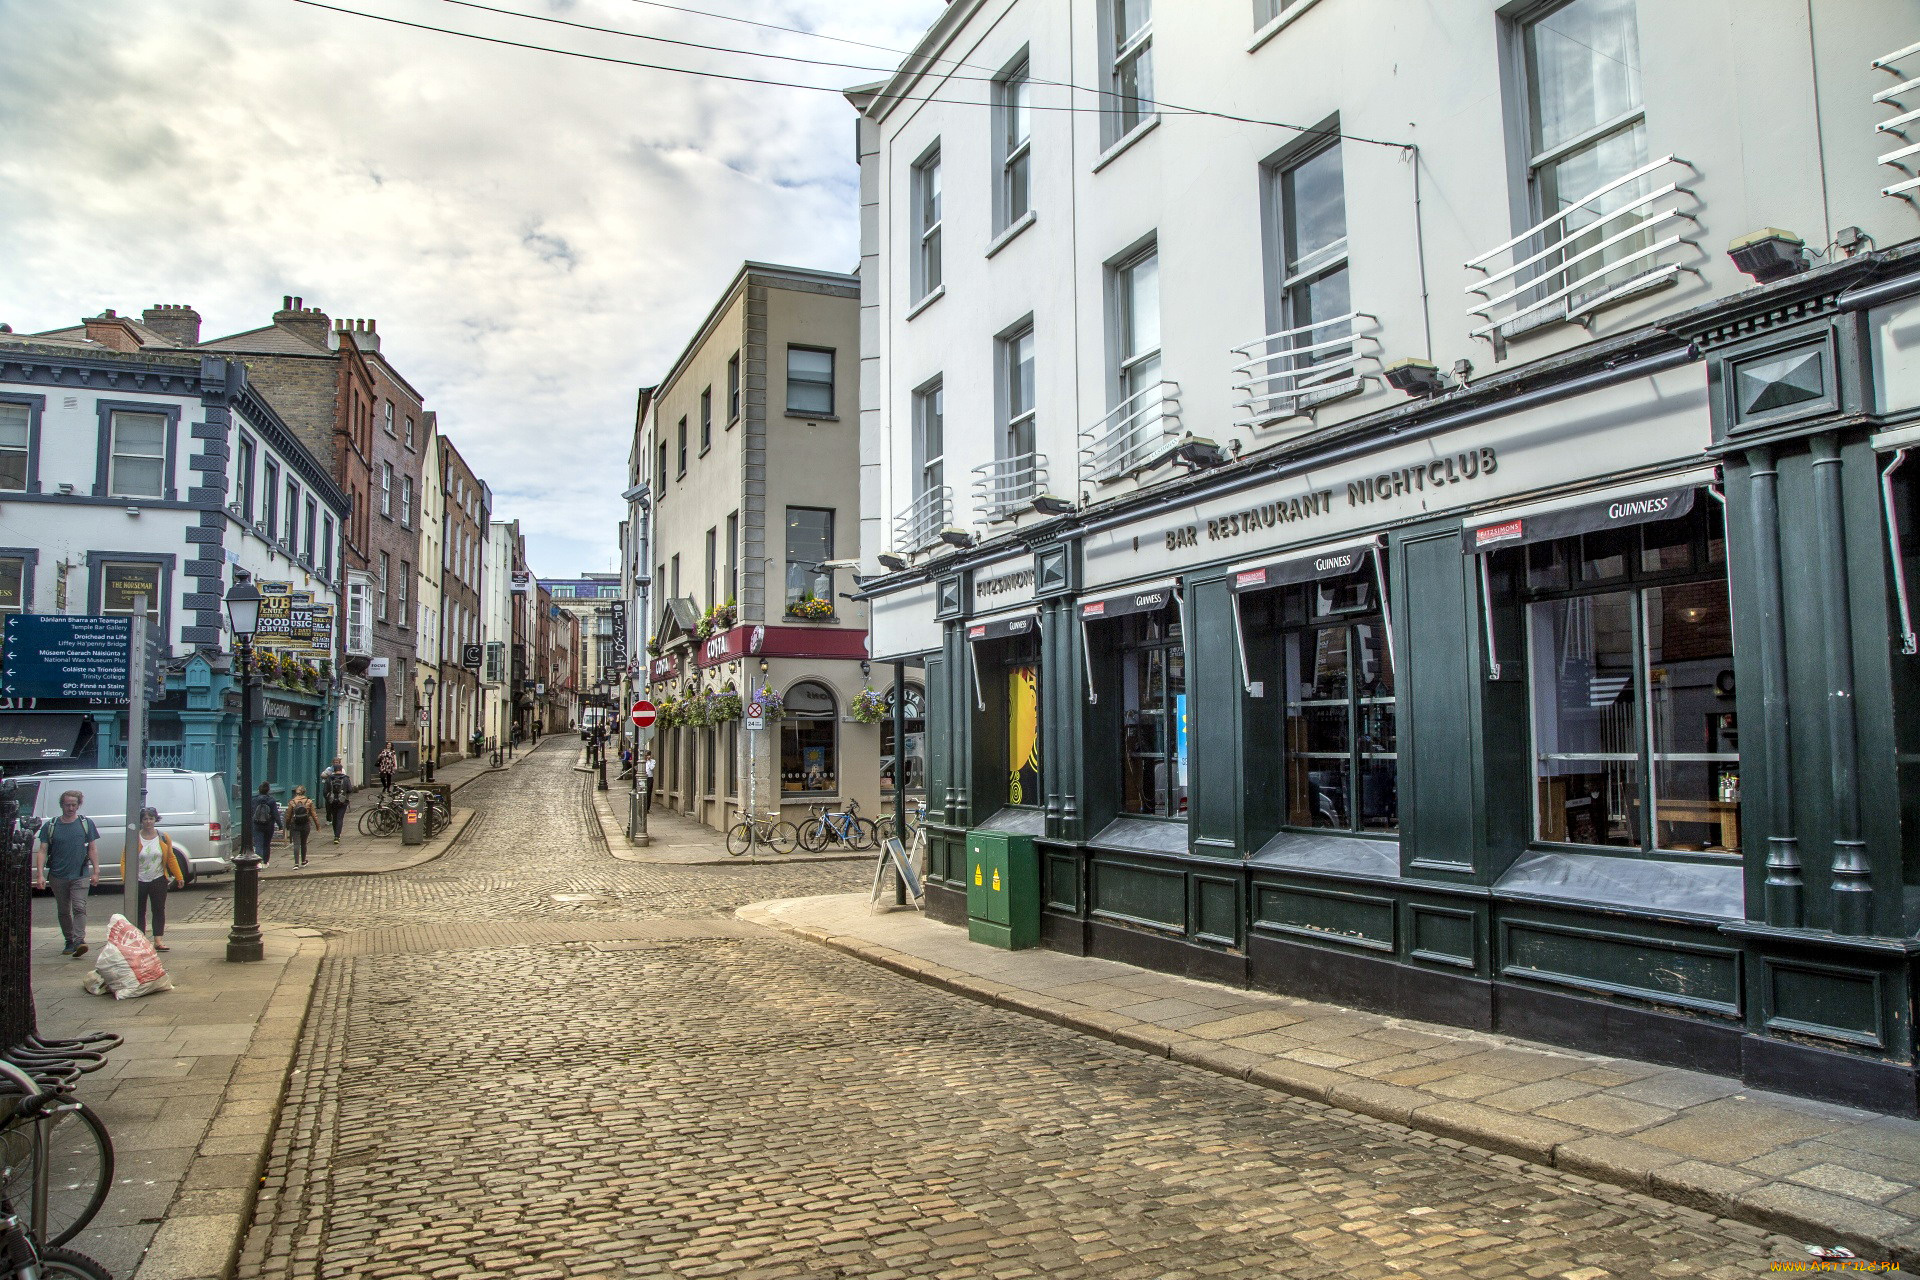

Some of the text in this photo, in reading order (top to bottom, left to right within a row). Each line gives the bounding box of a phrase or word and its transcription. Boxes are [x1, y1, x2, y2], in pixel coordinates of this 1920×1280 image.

[1165, 525, 1198, 551] BAR
[1207, 489, 1333, 542] RESTAURANT
[1347, 447, 1499, 508] NIGHTCLUB
[1608, 497, 1669, 519] GUINNESS
[1315, 554, 1351, 571] GUINNESS
[260, 596, 291, 609] PUB
[1135, 593, 1162, 606] GUINNESS
[258, 618, 290, 626] FOOD
[290, 611, 313, 621] IVE
[290, 620, 312, 628] USIC
[614, 611, 626, 652] PINTXO
[77, 640, 105, 648] Ha'penny
[706, 635, 727, 659] COSTA
[655, 657, 670, 676] COSTA
[887, 689, 921, 705] CSTA
